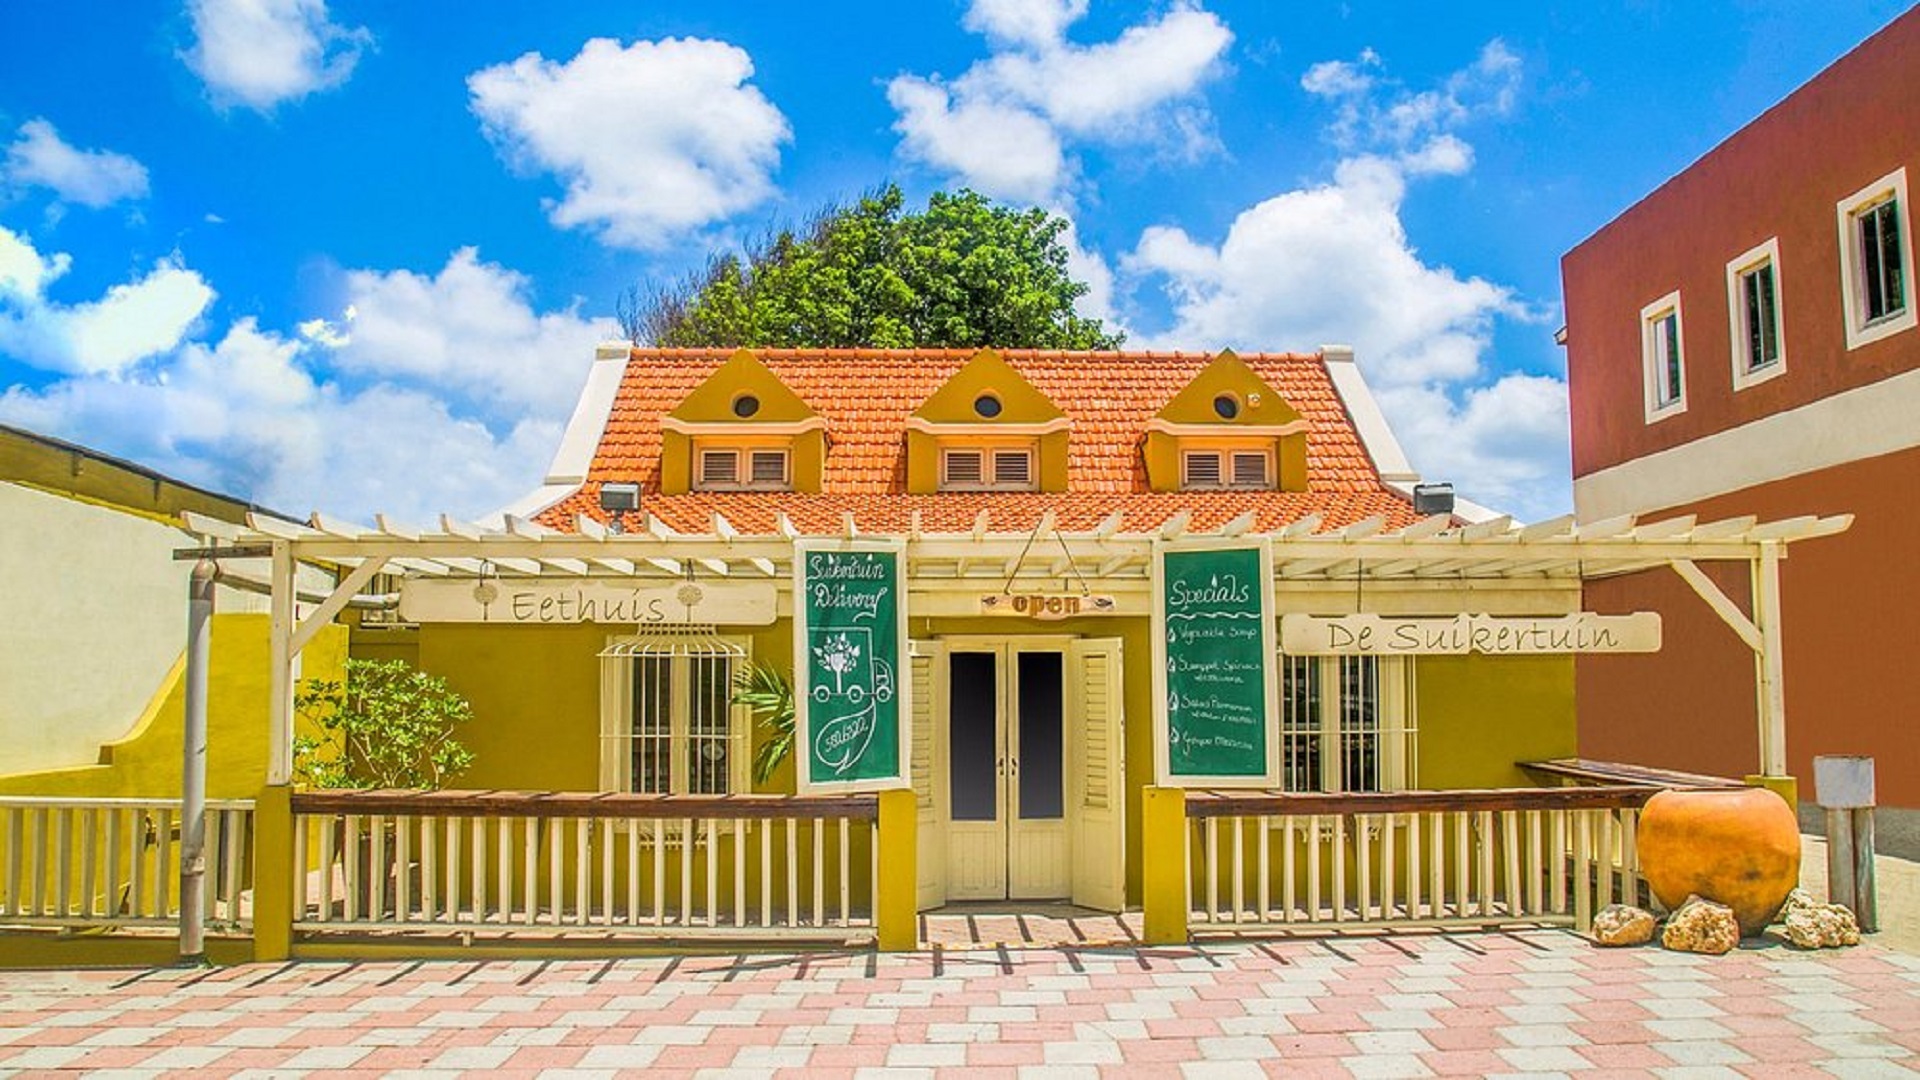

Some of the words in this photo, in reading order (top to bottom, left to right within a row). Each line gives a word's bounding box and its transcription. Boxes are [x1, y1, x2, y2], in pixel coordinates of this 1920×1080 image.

[512, 588, 665, 622] Eethuis
[807, 583, 888, 622] Delivery
[1011, 595, 1080, 617] open
[1169, 574, 1249, 612] Specials
[1326, 622, 1374, 651] De
[1388, 618, 1619, 651] Suikertuin
